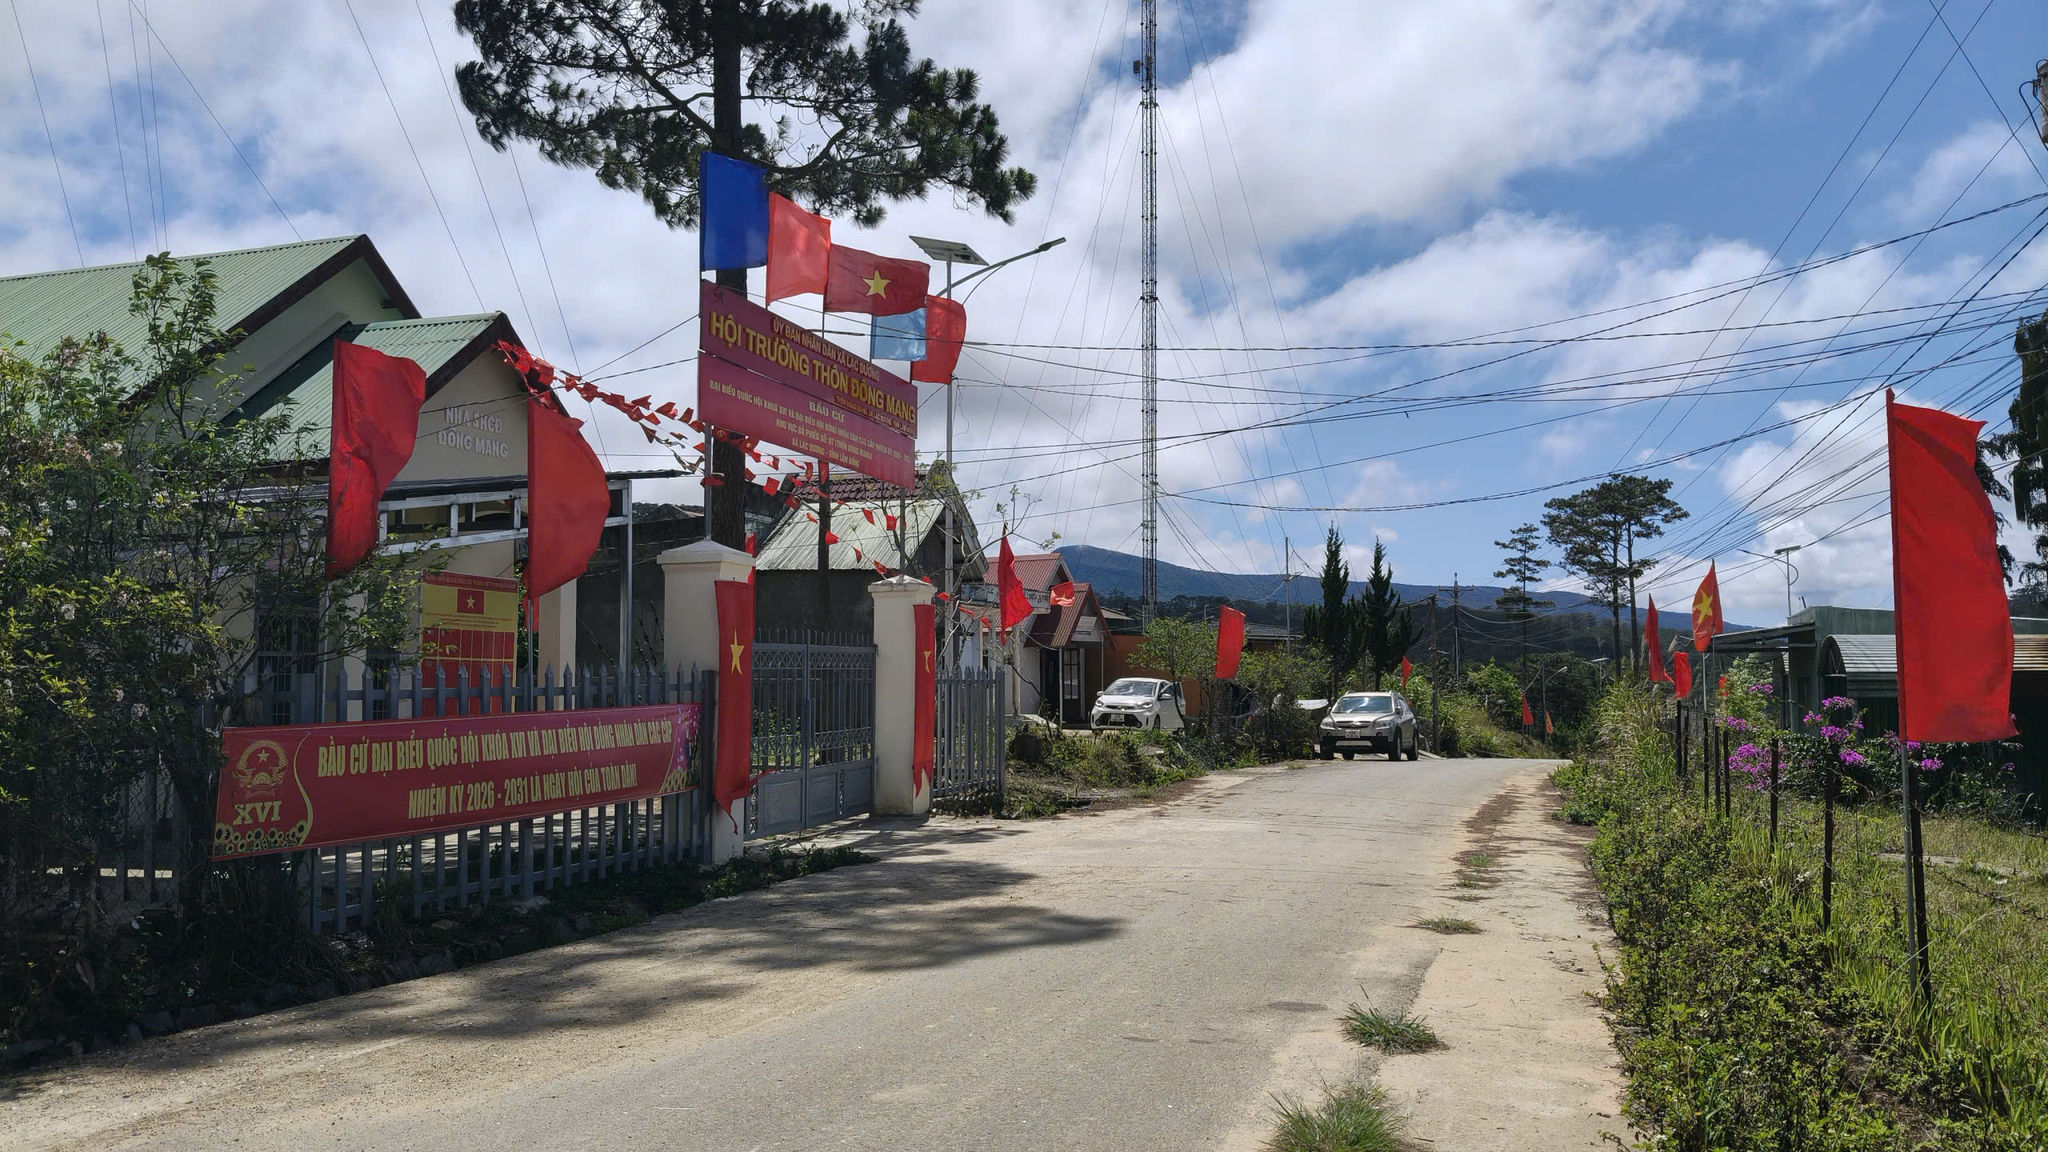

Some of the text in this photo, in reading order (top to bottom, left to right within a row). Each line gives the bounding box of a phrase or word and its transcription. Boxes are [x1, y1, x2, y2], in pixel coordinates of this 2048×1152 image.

[786, 324, 800, 343] BAN
[711, 312, 741, 347] HỘI
[745, 327, 809, 376] TRƯỜNG
[812, 360, 848, 394] THÔN
[886, 394, 916, 424] MANG
[476, 437, 509, 458] MANG
[318, 735, 346, 776] BẦU
[350, 736, 369, 773] CỬ
[371, 741, 393, 777] ĐẠI
[397, 729, 424, 769] BIỂU
[427, 728, 458, 769] QUỐC
[460, 731, 479, 768] HỘI
[482, 729, 509, 760] KHÓA
[510, 732, 526, 757] XVI
[527, 726, 541, 755] VÀ
[559, 719, 578, 752] BIỂU
[578, 722, 593, 755] HỘI
[233, 801, 282, 825] XVI
[408, 782, 446, 823] NHIỆM
[450, 780, 464, 812] KỲ
[467, 781, 494, 810] 2026
[505, 777, 528, 805] 2031
[531, 771, 542, 801] LÀ
[543, 768, 565, 799] NGÀY
[568, 766, 583, 800] HỘI
[585, 762, 601, 793] CỦA
[601, 762, 620, 790] TOÀN
